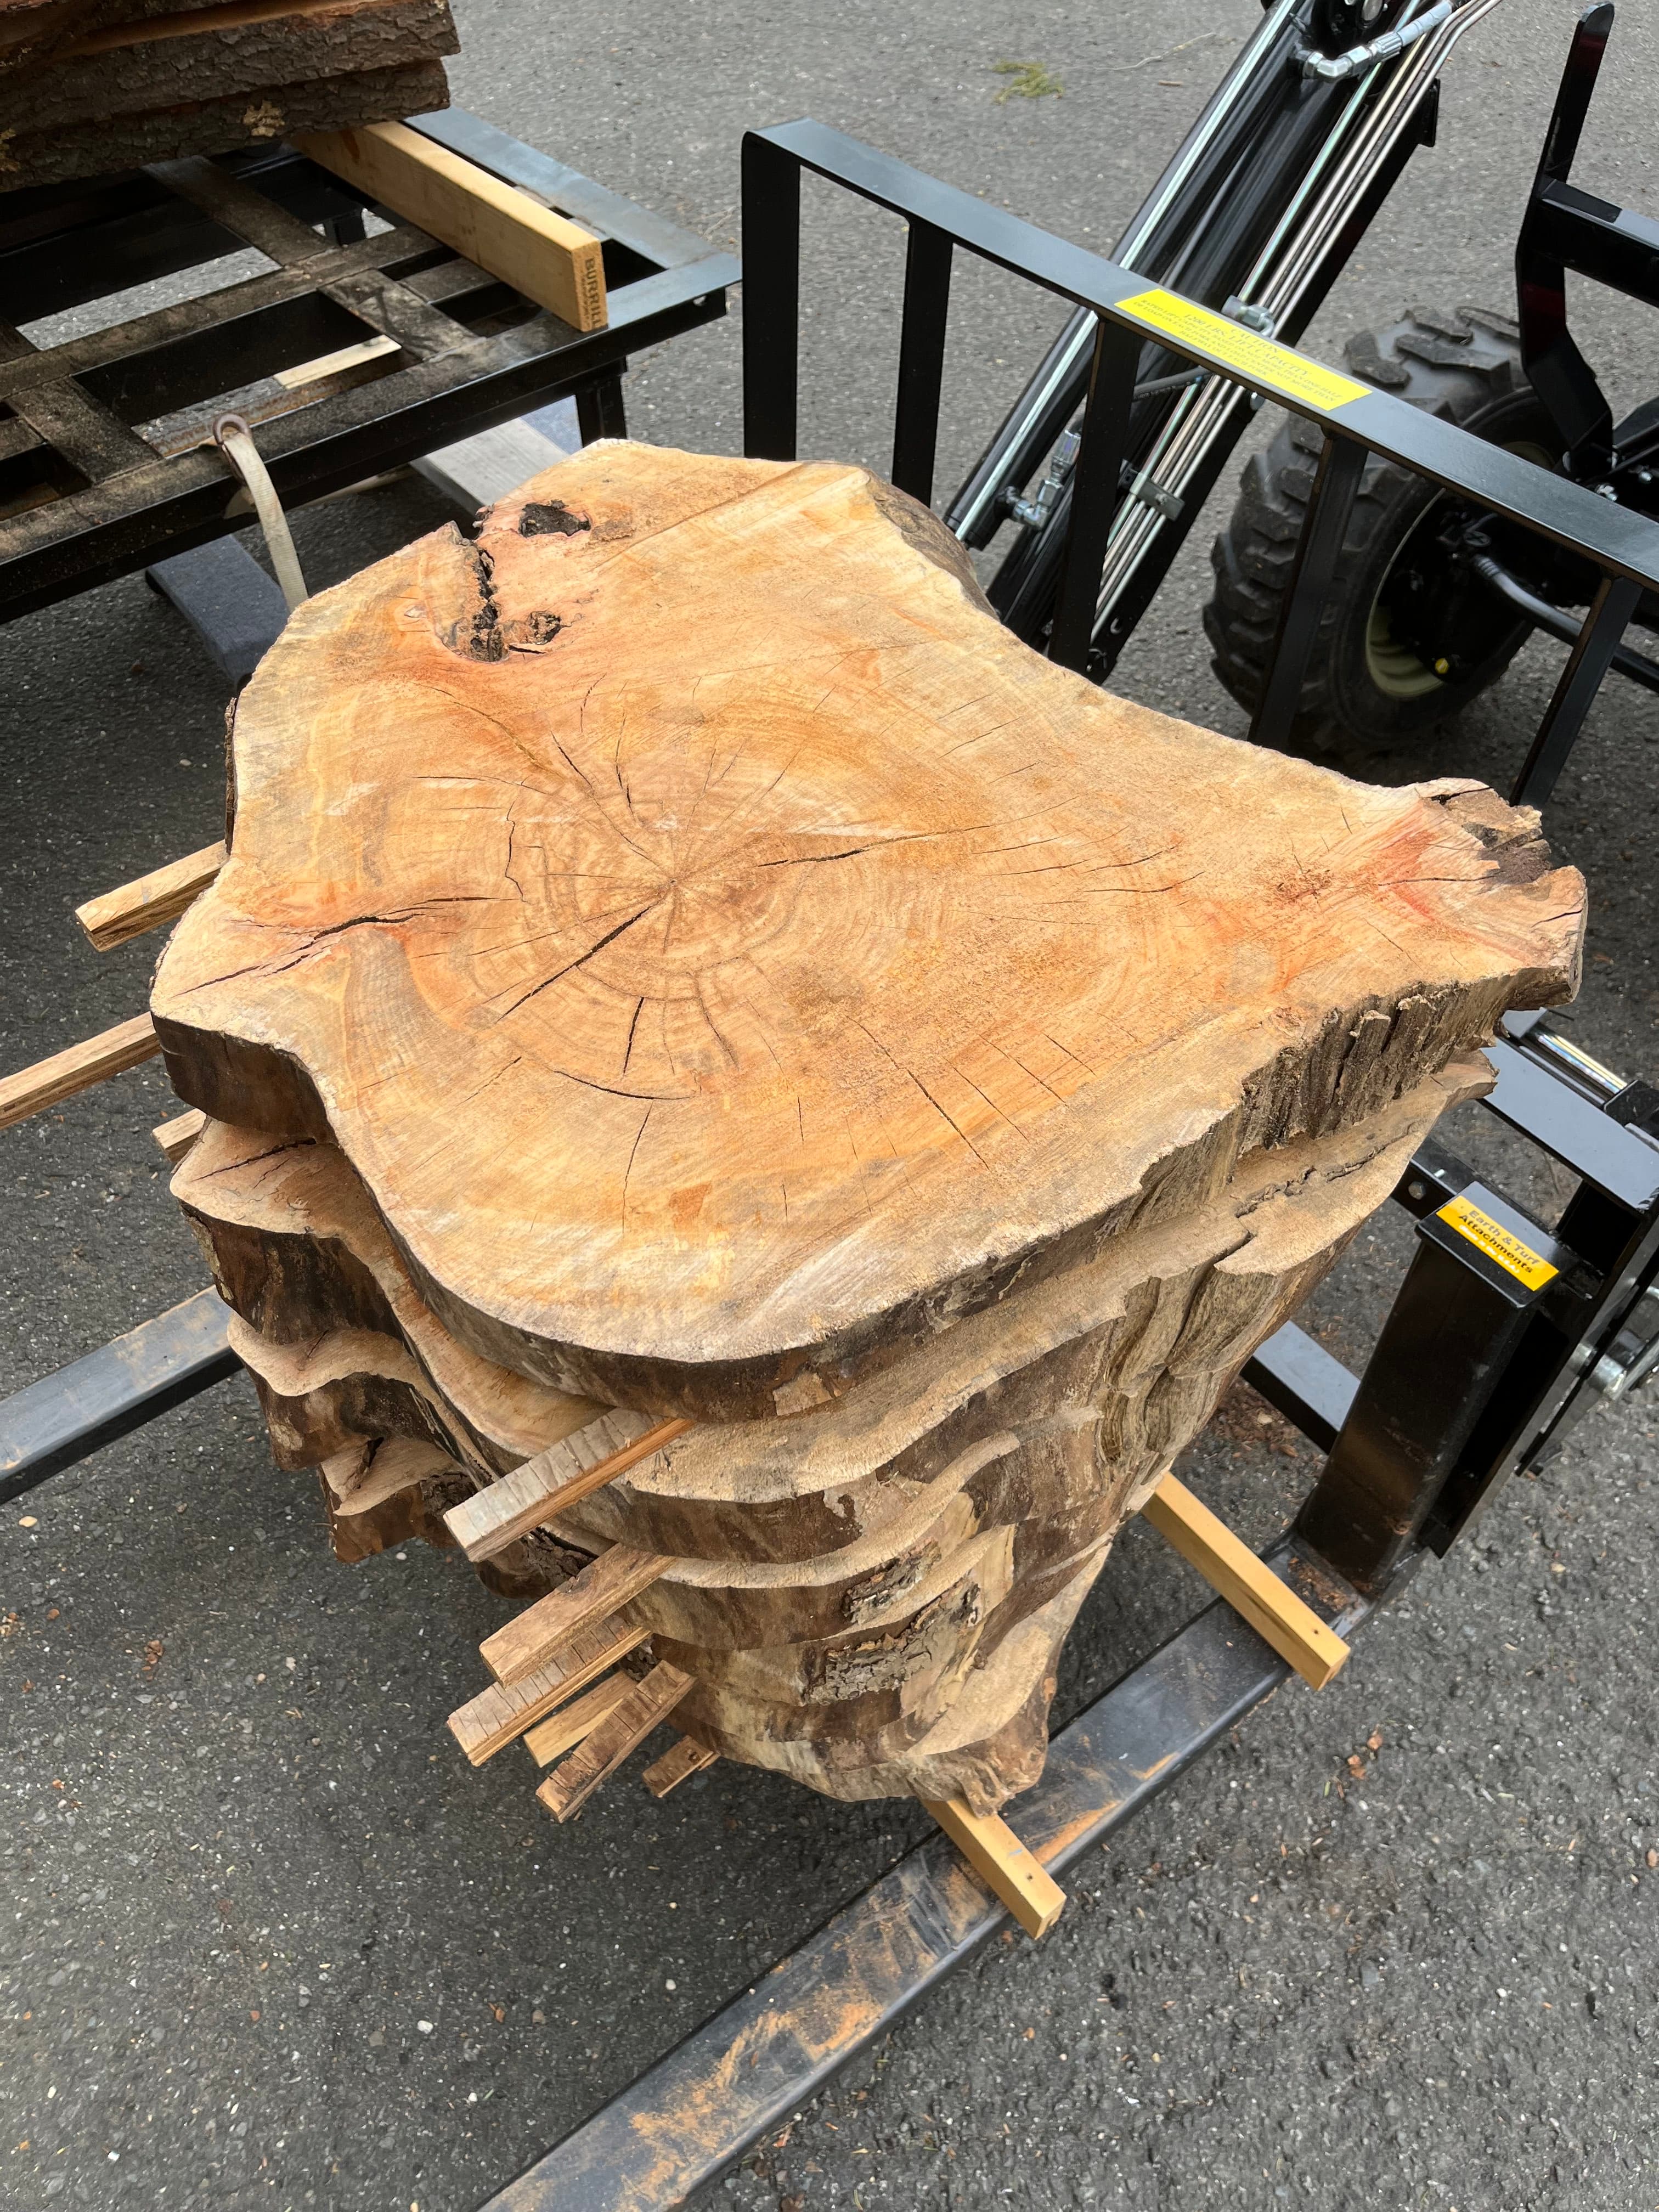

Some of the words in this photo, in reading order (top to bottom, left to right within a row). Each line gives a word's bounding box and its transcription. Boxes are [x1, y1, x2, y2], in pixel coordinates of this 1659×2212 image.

[585, 257, 601, 328] BURRILL
[1139, 299, 1165, 312] RATED
[1161, 309, 1180, 319] LIFT
[1177, 317, 1212, 335] CAPACITY
[1210, 334, 1236, 347] BASED
[1244, 350, 1262, 359] NOT
[1260, 358, 1284, 370] MORE
[1281, 369, 1305, 380] THAN
[1142, 306, 1163, 317] LOAD
[1244, 357, 1276, 373] CENTER
[1273, 371, 1291, 380] NOT
[1289, 379, 1313, 391] MORE
[1311, 390, 1335, 402] THAN
[1183, 314, 1206, 325] 1200
[1228, 336, 1255, 349] LIFT
[1254, 348, 1311, 376] CAPACITY
[1229, 329, 1278, 353] CAUTION
[1458, 1214, 1533, 1273] Attachments
[1469, 1210, 1502, 1236] Earth
[1502, 1236, 1514, 1245] &
[1513, 1244, 1540, 1266] Turf
